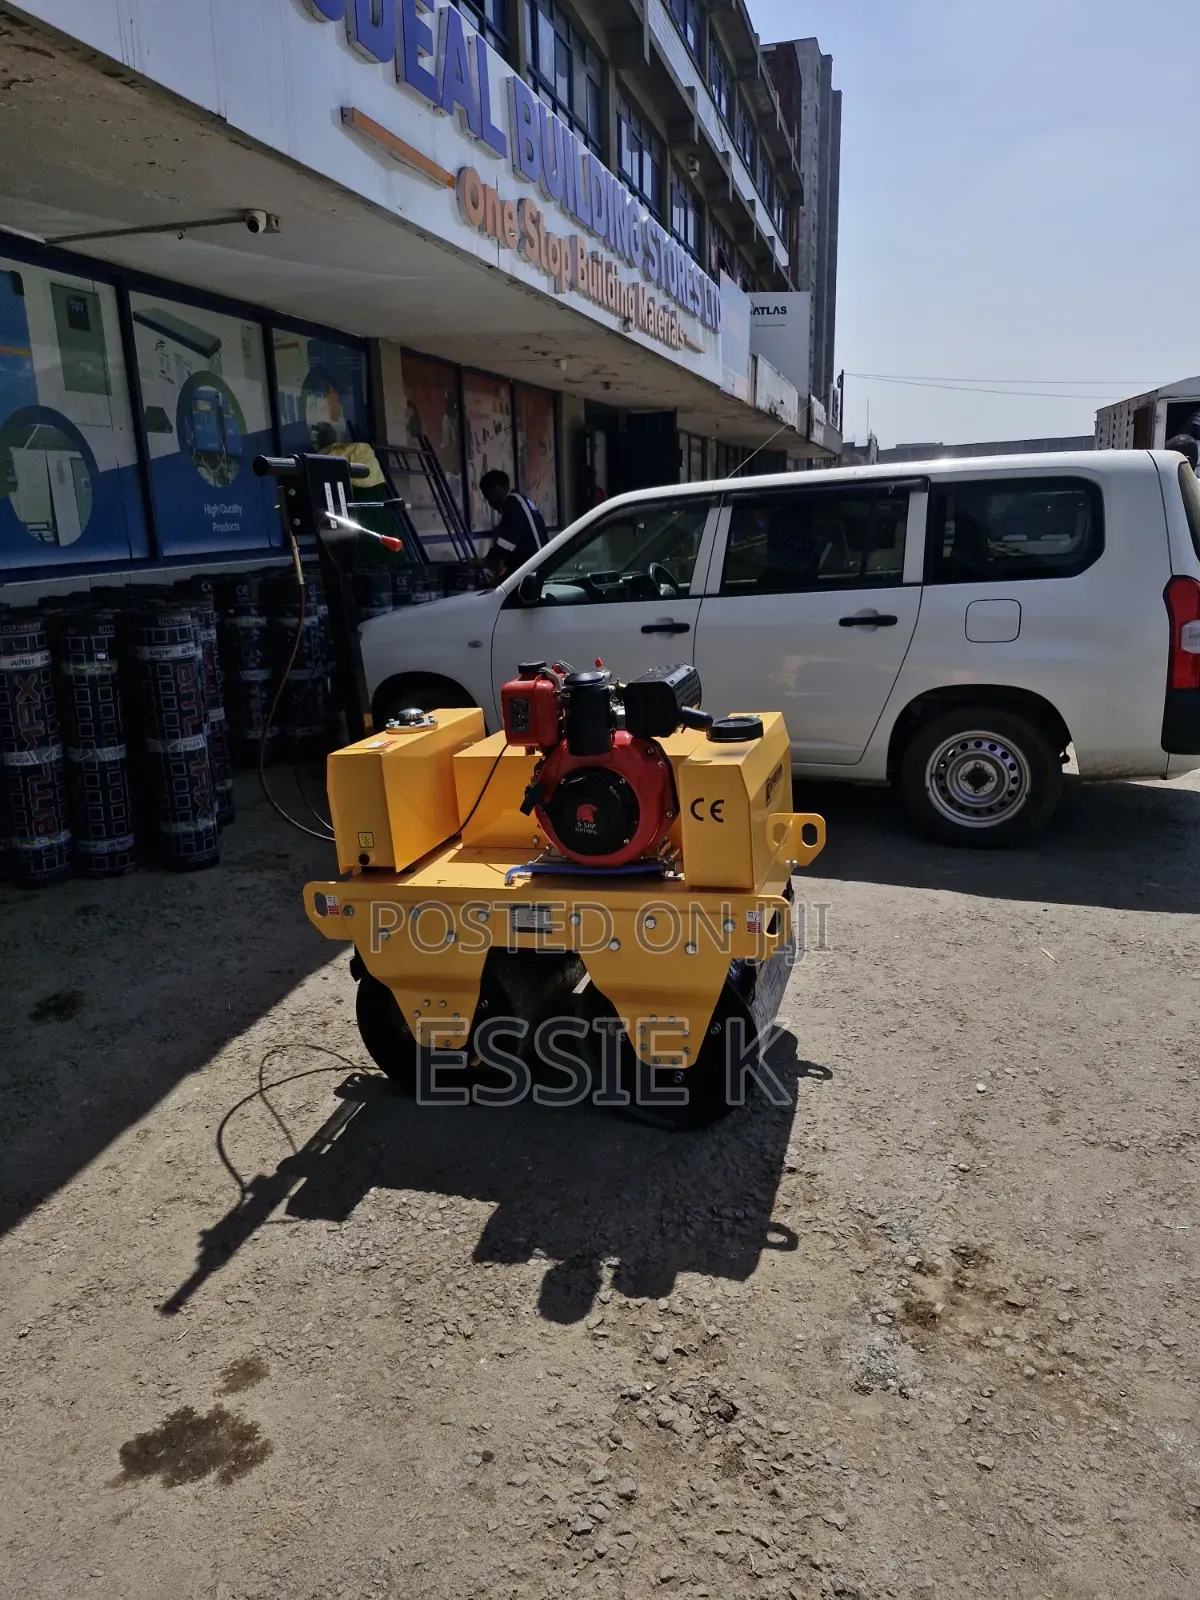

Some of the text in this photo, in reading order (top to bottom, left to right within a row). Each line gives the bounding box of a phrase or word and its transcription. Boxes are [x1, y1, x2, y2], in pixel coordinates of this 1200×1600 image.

[507, 75, 644, 268] BUILDING
[642, 218, 701, 317] STORES
[456, 166, 685, 350] One Stop Building Materials
[752, 306, 787, 315] ATLAS
[204, 504, 242, 517] High Quality
[213, 522, 240, 532] Products
[690, 798, 724, 823] CE
